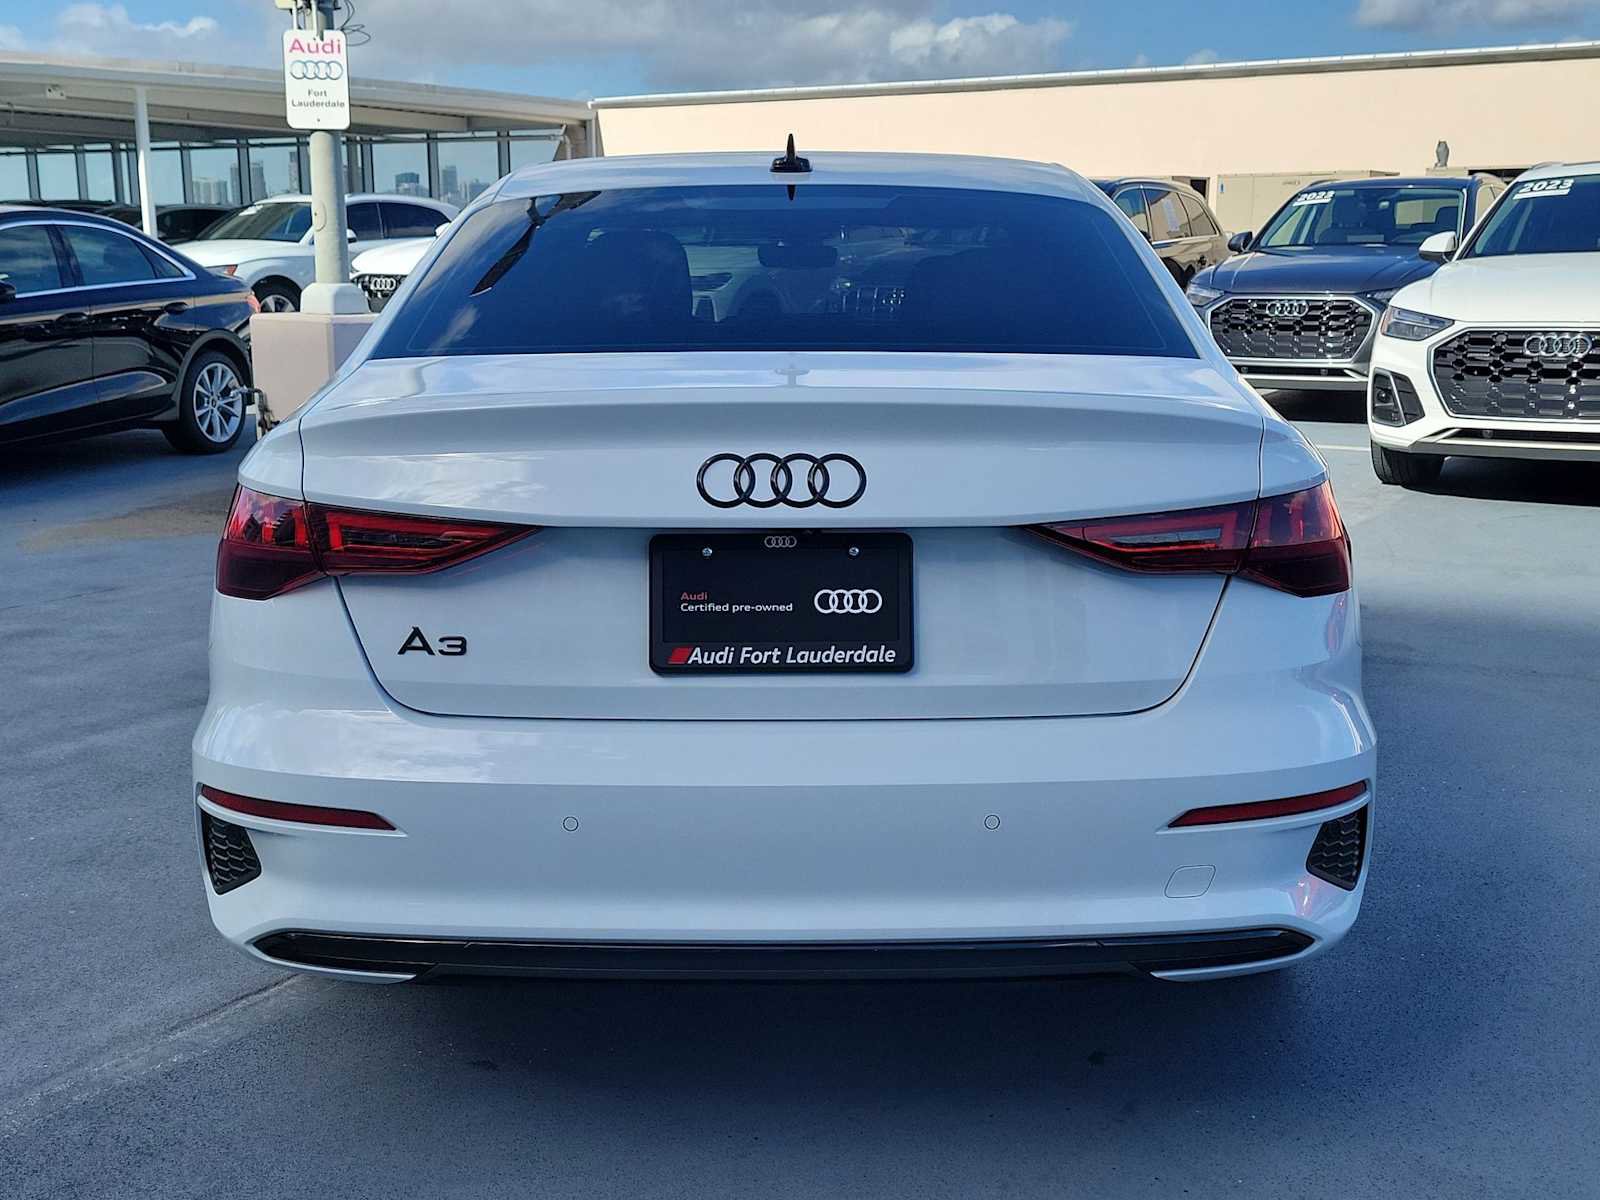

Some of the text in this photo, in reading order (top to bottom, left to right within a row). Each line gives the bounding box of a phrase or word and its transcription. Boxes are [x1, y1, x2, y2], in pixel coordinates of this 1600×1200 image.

[289, 38, 342, 54] Audi
[307, 89, 327, 97] Fort
[291, 99, 345, 108] Lauderdale
[680, 592, 708, 601] Audi
[680, 603, 793, 614] Certified pre-owned
[397, 626, 467, 656] A3
[687, 645, 897, 665] Audi Fort Lauderdale
